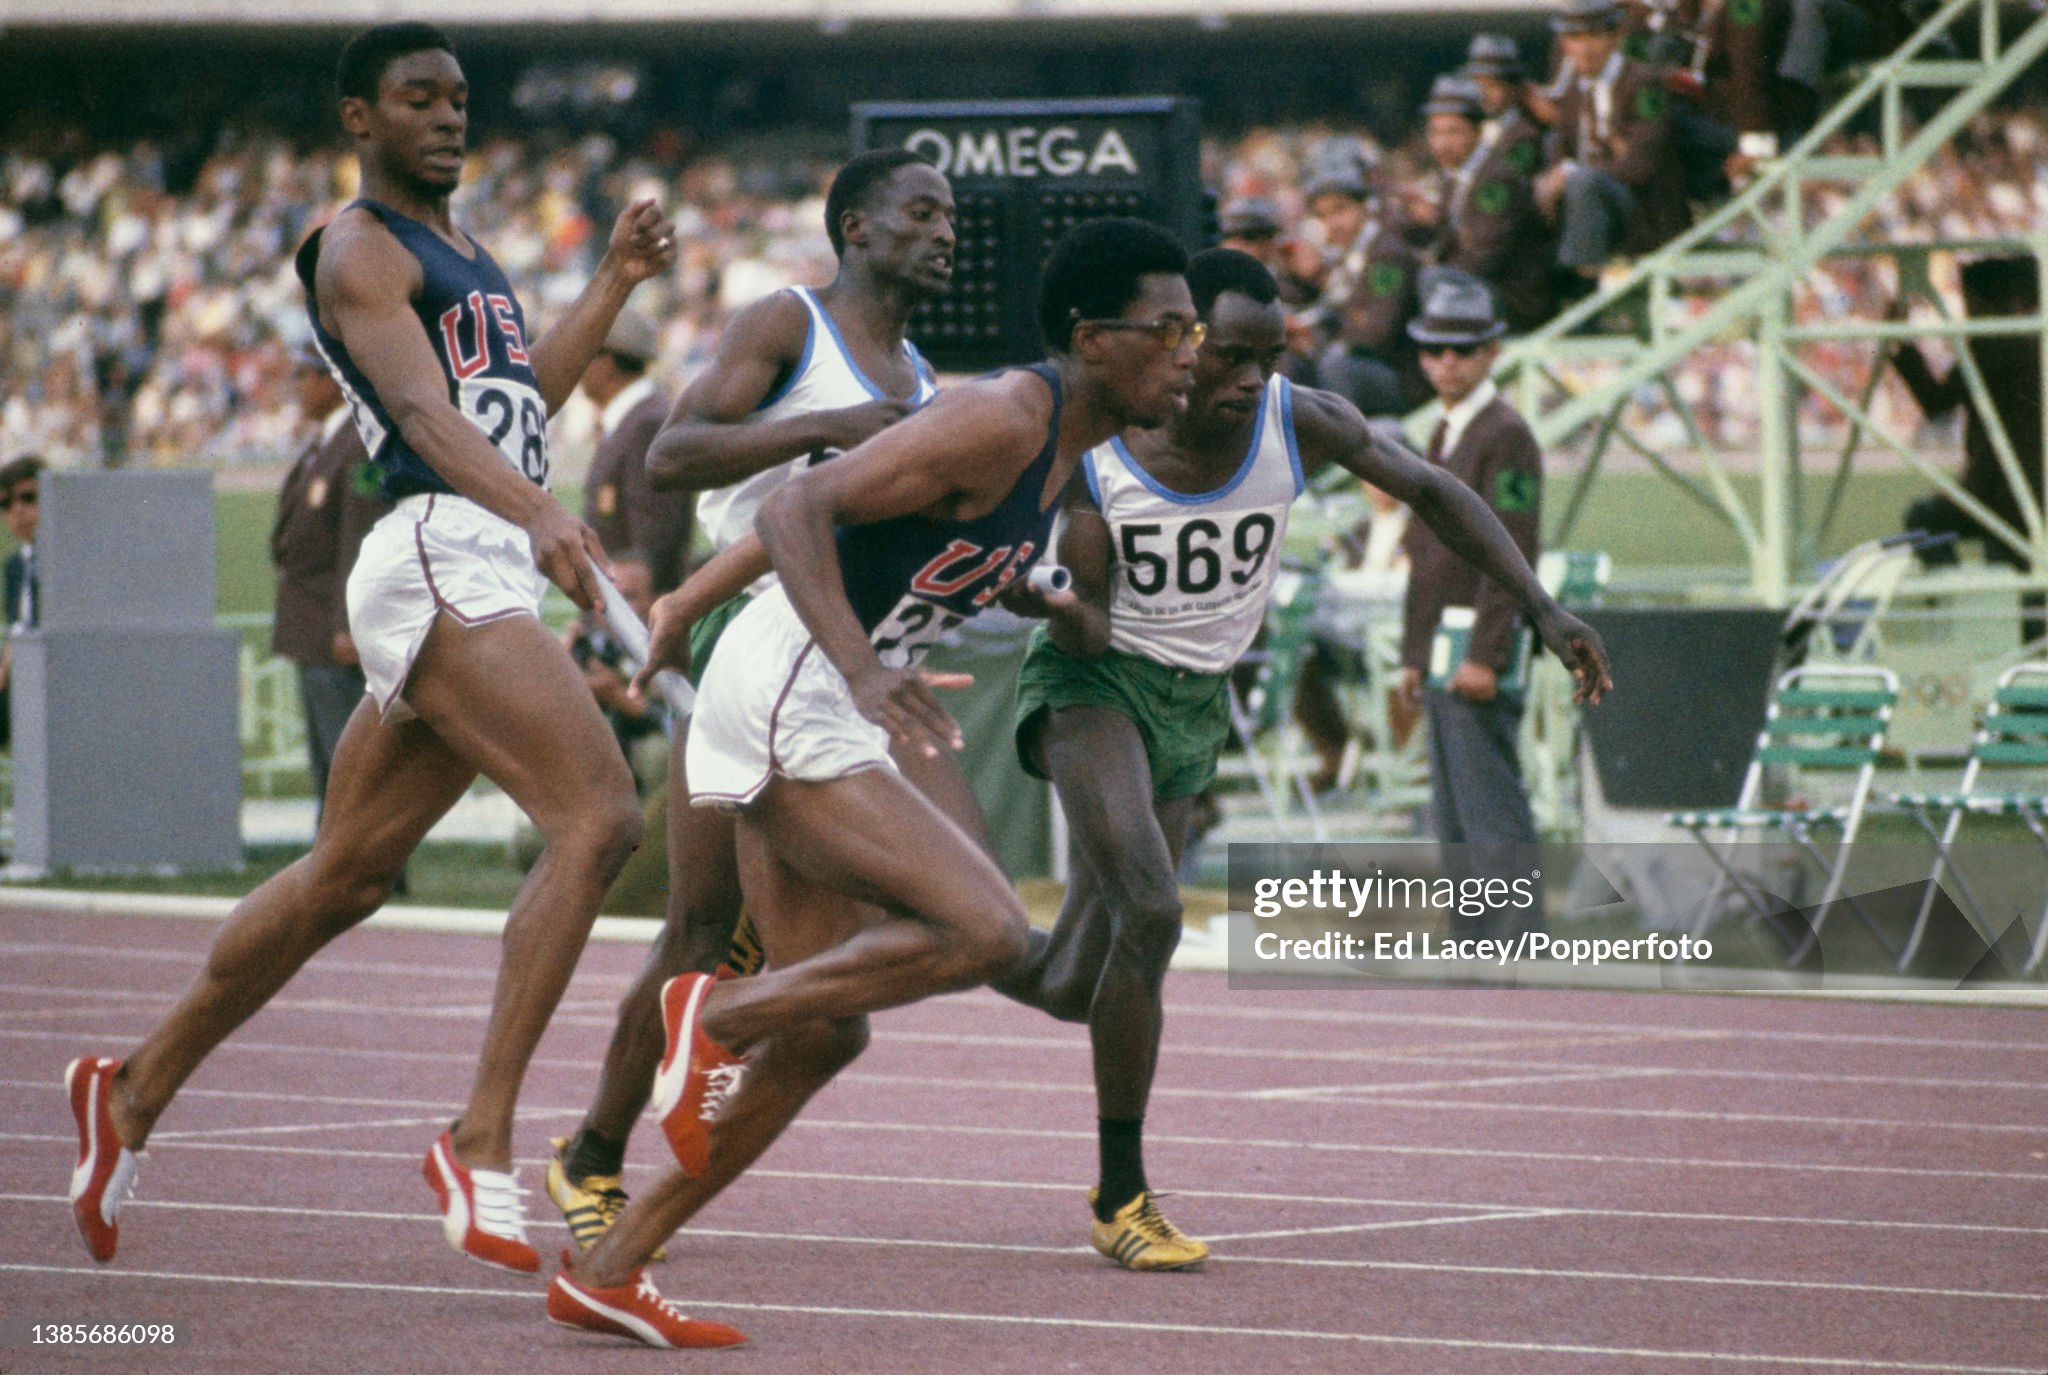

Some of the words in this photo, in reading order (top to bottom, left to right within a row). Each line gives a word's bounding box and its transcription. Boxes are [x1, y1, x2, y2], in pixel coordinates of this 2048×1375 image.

[904, 125, 1139, 178] OMEGA
[475, 387, 550, 486] 28
[1120, 512, 1276, 597] 569
